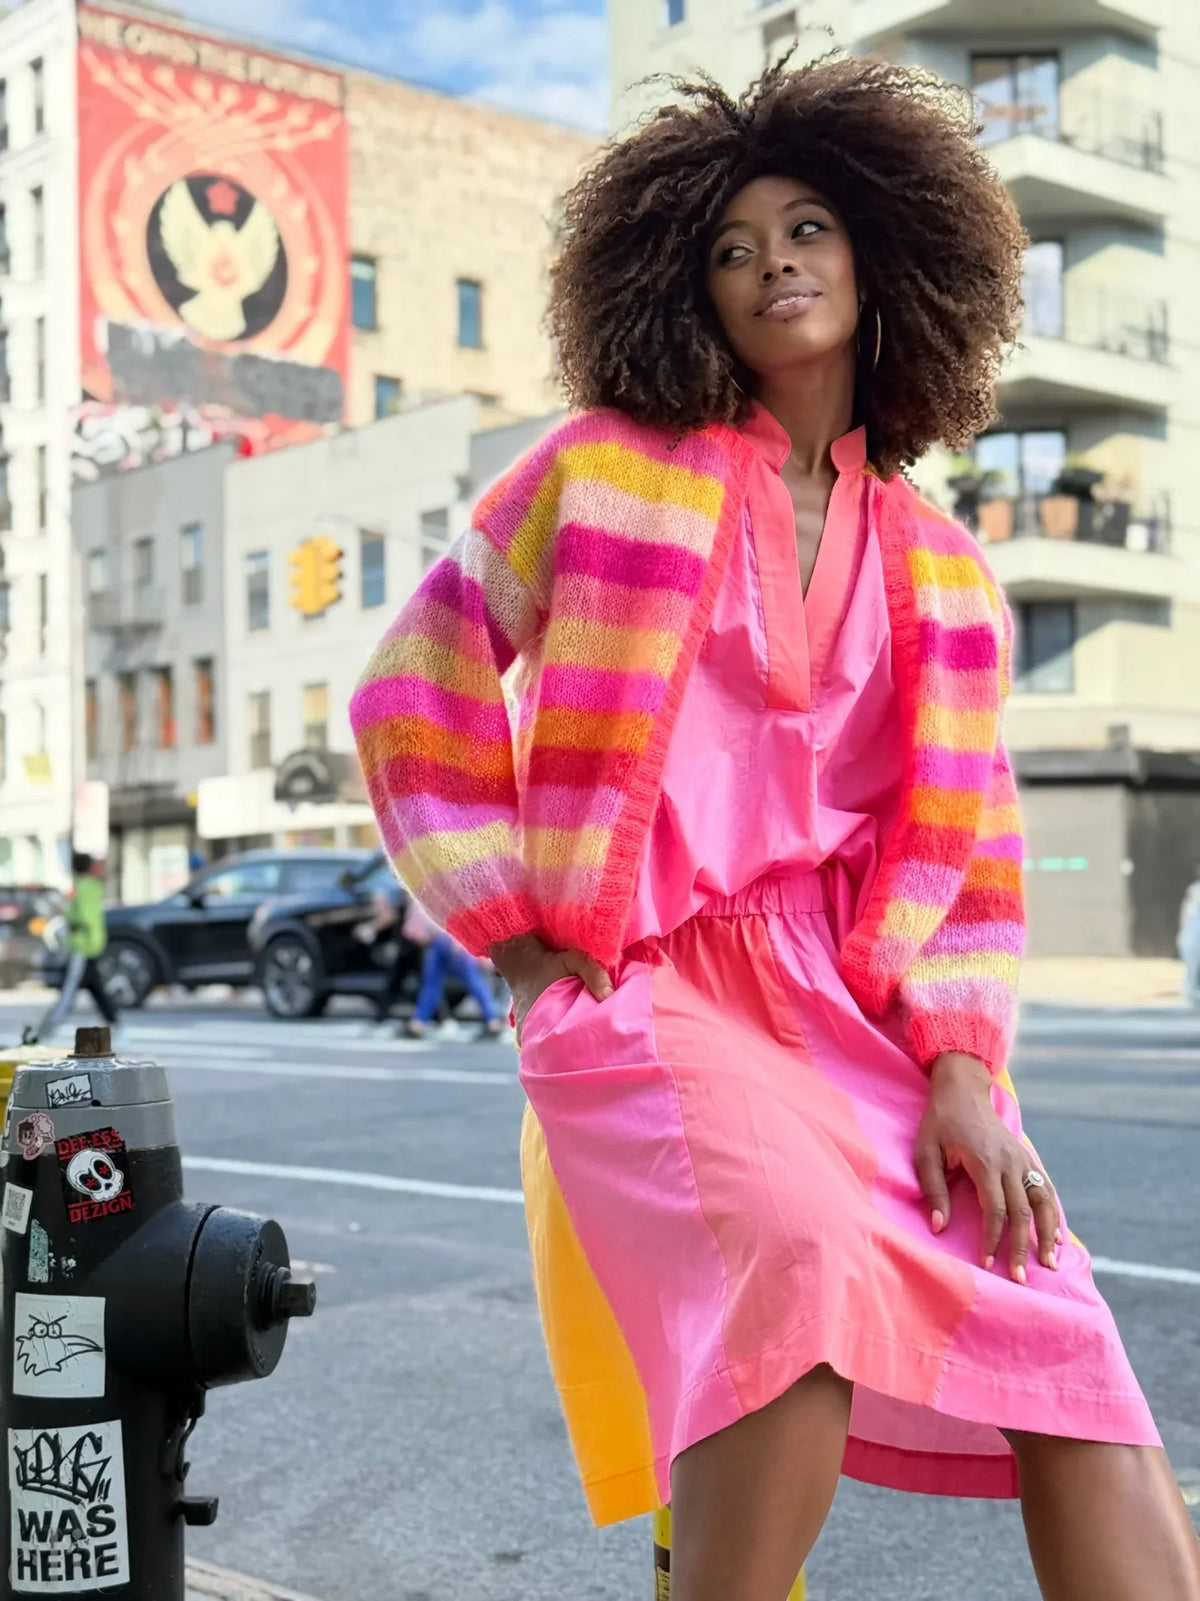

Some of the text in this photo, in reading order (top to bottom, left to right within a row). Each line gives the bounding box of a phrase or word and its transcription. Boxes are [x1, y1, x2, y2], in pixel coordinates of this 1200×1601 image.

[69, 1196, 132, 1223] DEZIGN
[17, 1504, 117, 1542] WAS
[17, 1542, 119, 1582] HERE
